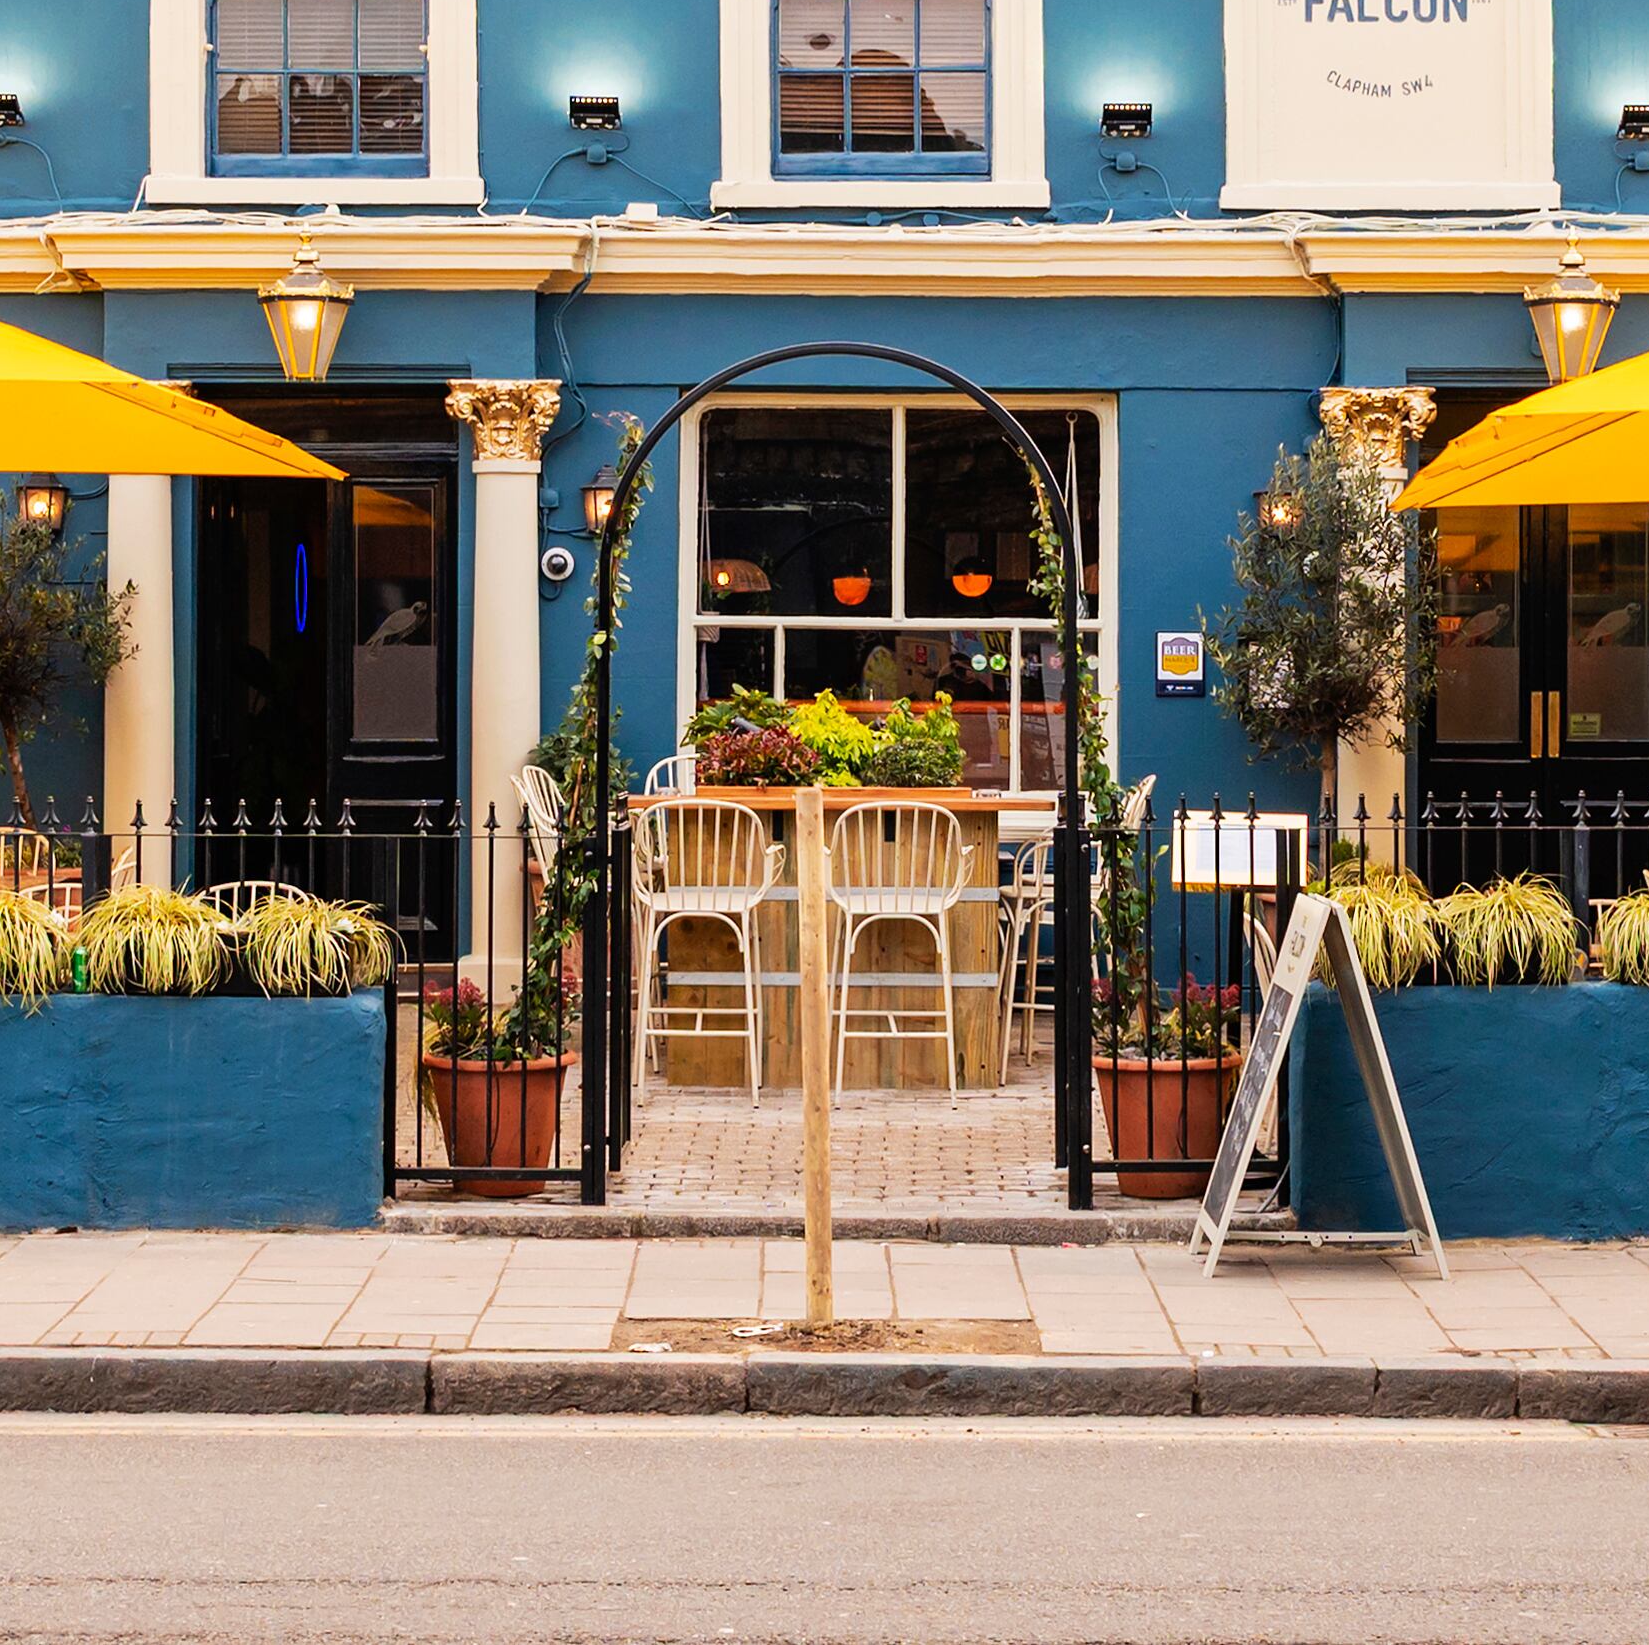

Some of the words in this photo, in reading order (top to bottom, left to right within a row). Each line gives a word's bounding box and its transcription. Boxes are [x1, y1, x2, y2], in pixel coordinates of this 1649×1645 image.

[1327, 70, 1392, 97] CLAPHAM
[1401, 75, 1434, 95] SW4
[1164, 645, 1196, 655] BEER
